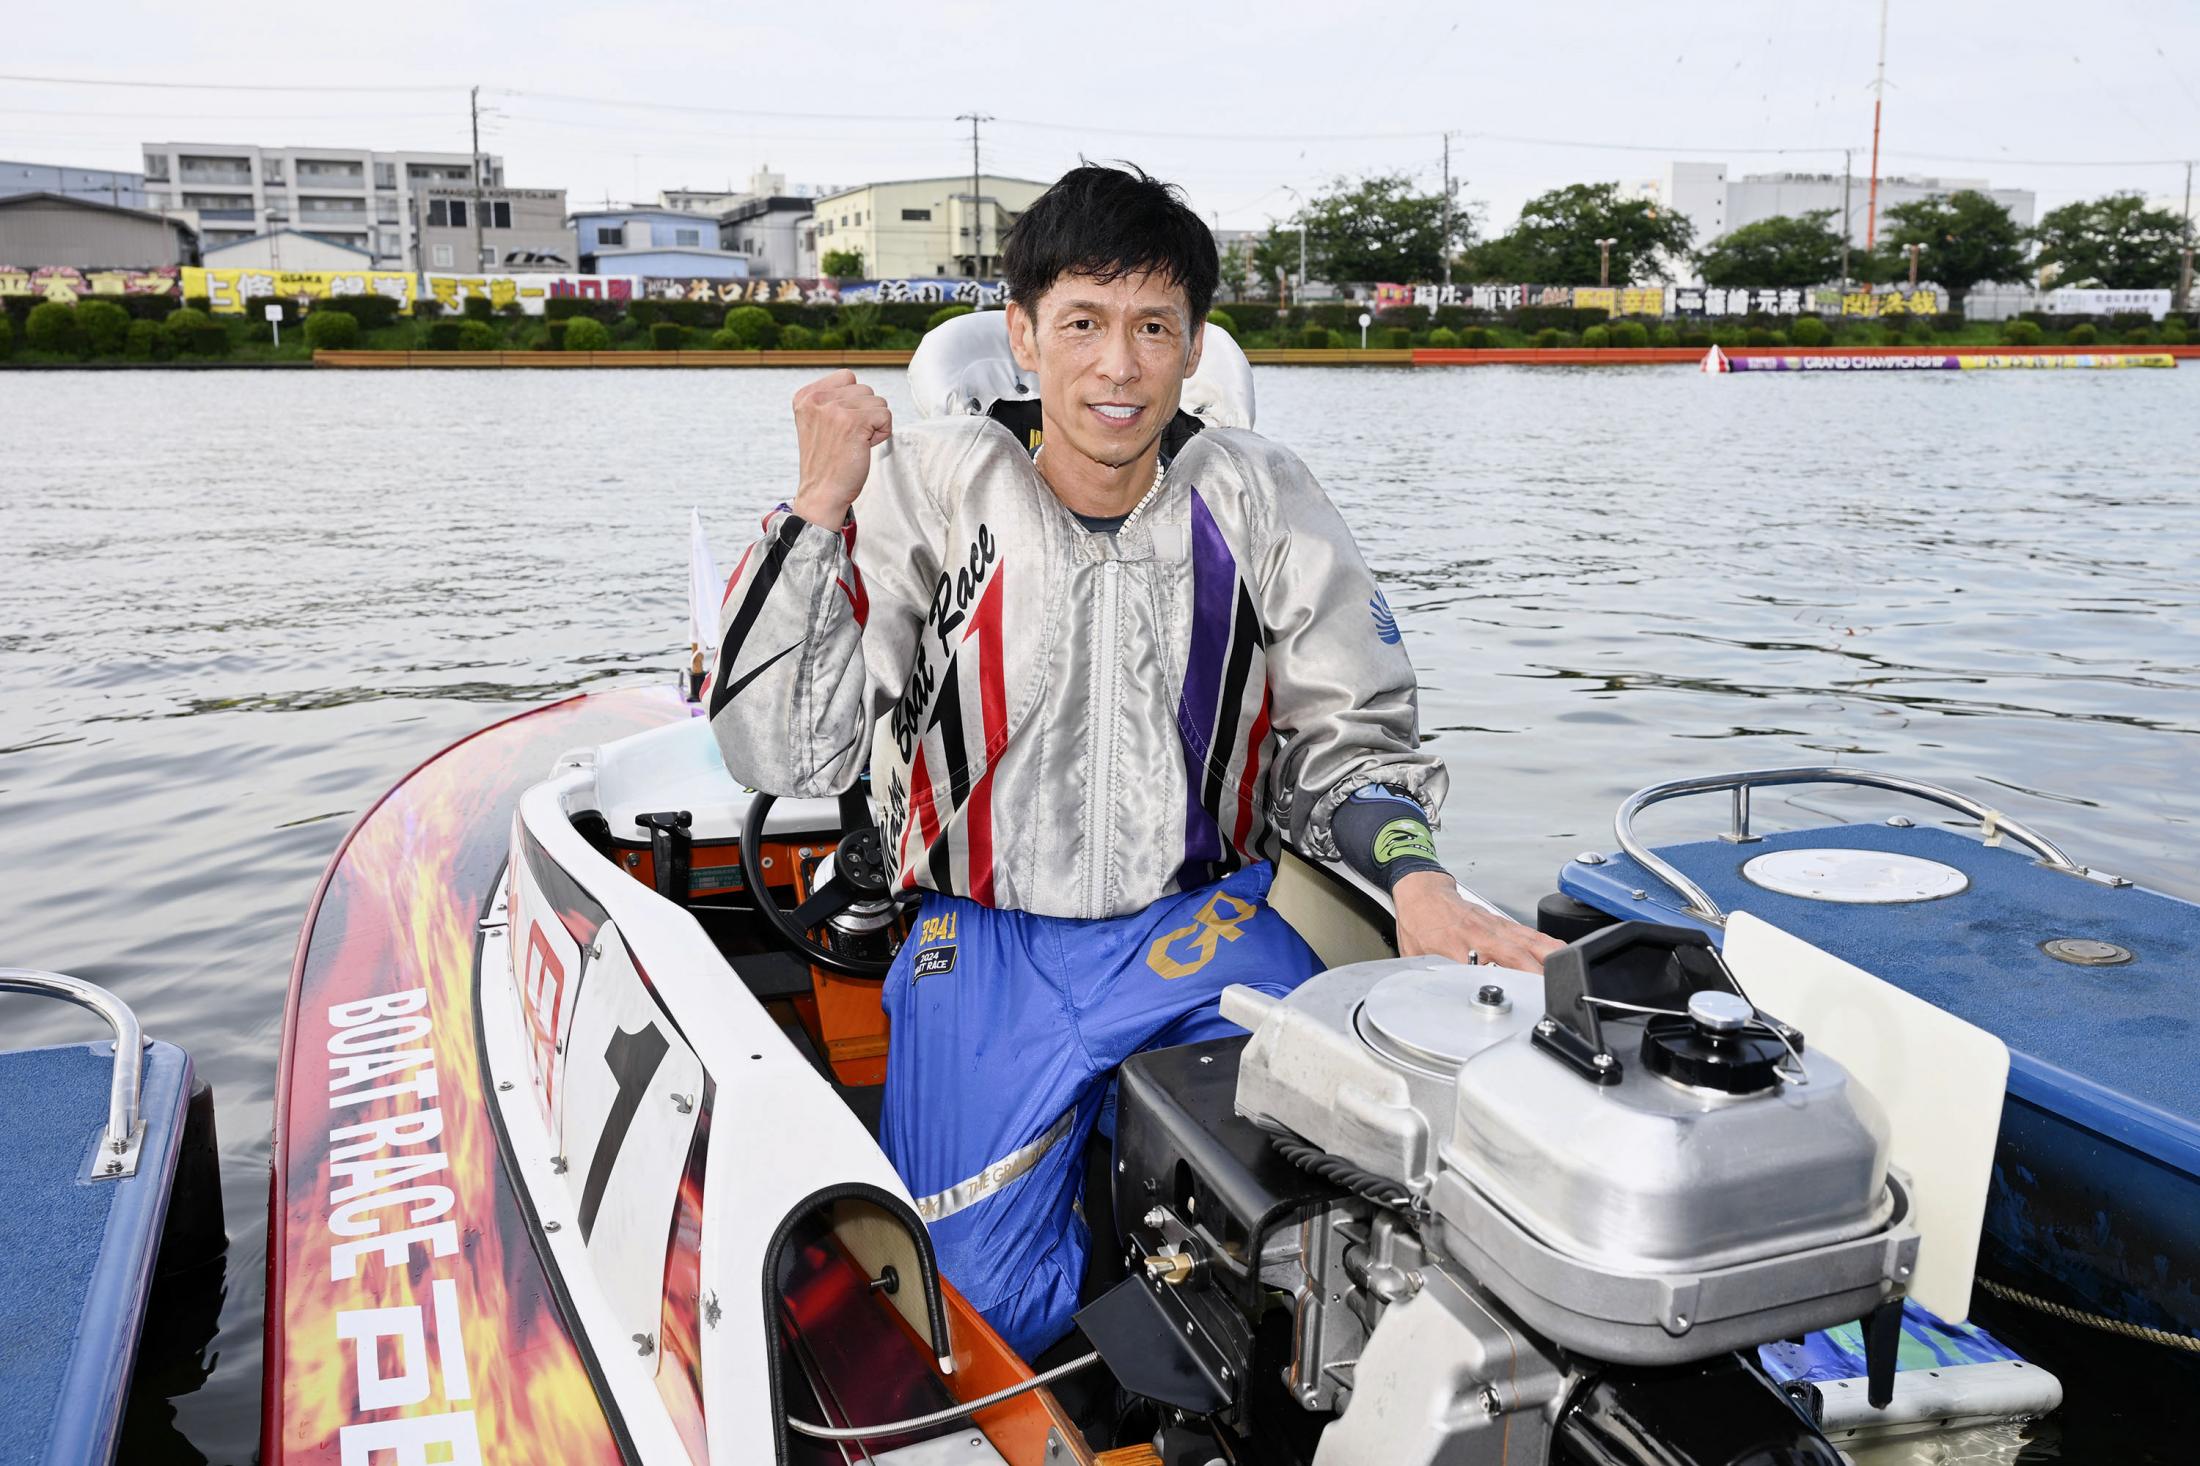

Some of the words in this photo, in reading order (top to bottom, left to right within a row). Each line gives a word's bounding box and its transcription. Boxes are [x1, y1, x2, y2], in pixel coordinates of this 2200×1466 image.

[929, 523, 995, 658] Race
[919, 911, 957, 947] 3941
[926, 960, 948, 971] RACE
[327, 987, 439, 1109] BOAT
[328, 1107, 460, 1282] RACE
[578, 1020, 670, 1248] 1
